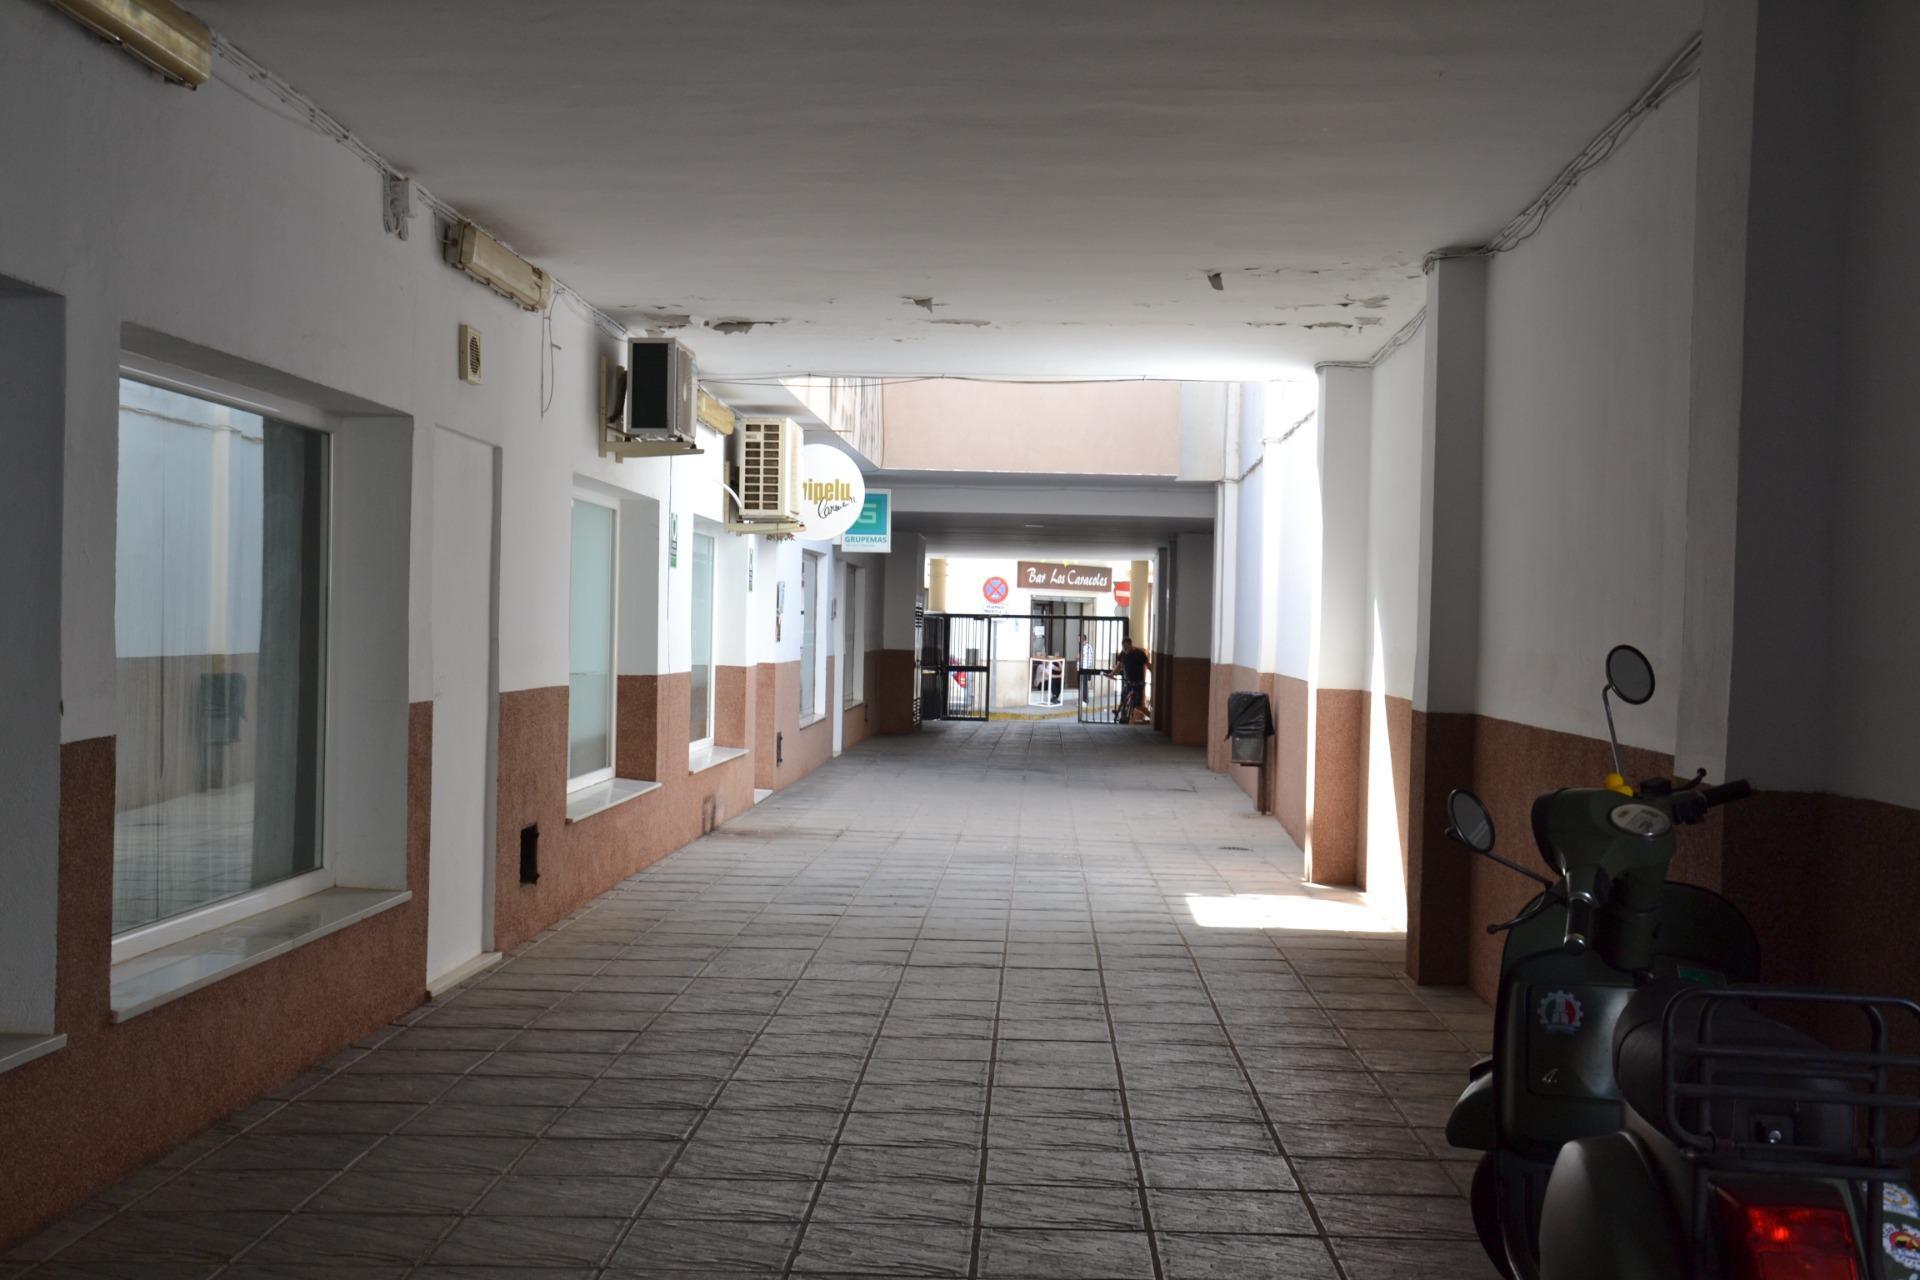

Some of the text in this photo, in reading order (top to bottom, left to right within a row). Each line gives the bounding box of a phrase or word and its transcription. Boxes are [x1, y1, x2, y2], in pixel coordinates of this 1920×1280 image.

[845, 535, 887, 544] GRUPEMAS
[1027, 567, 1108, 587] Bar Los Caracoles
